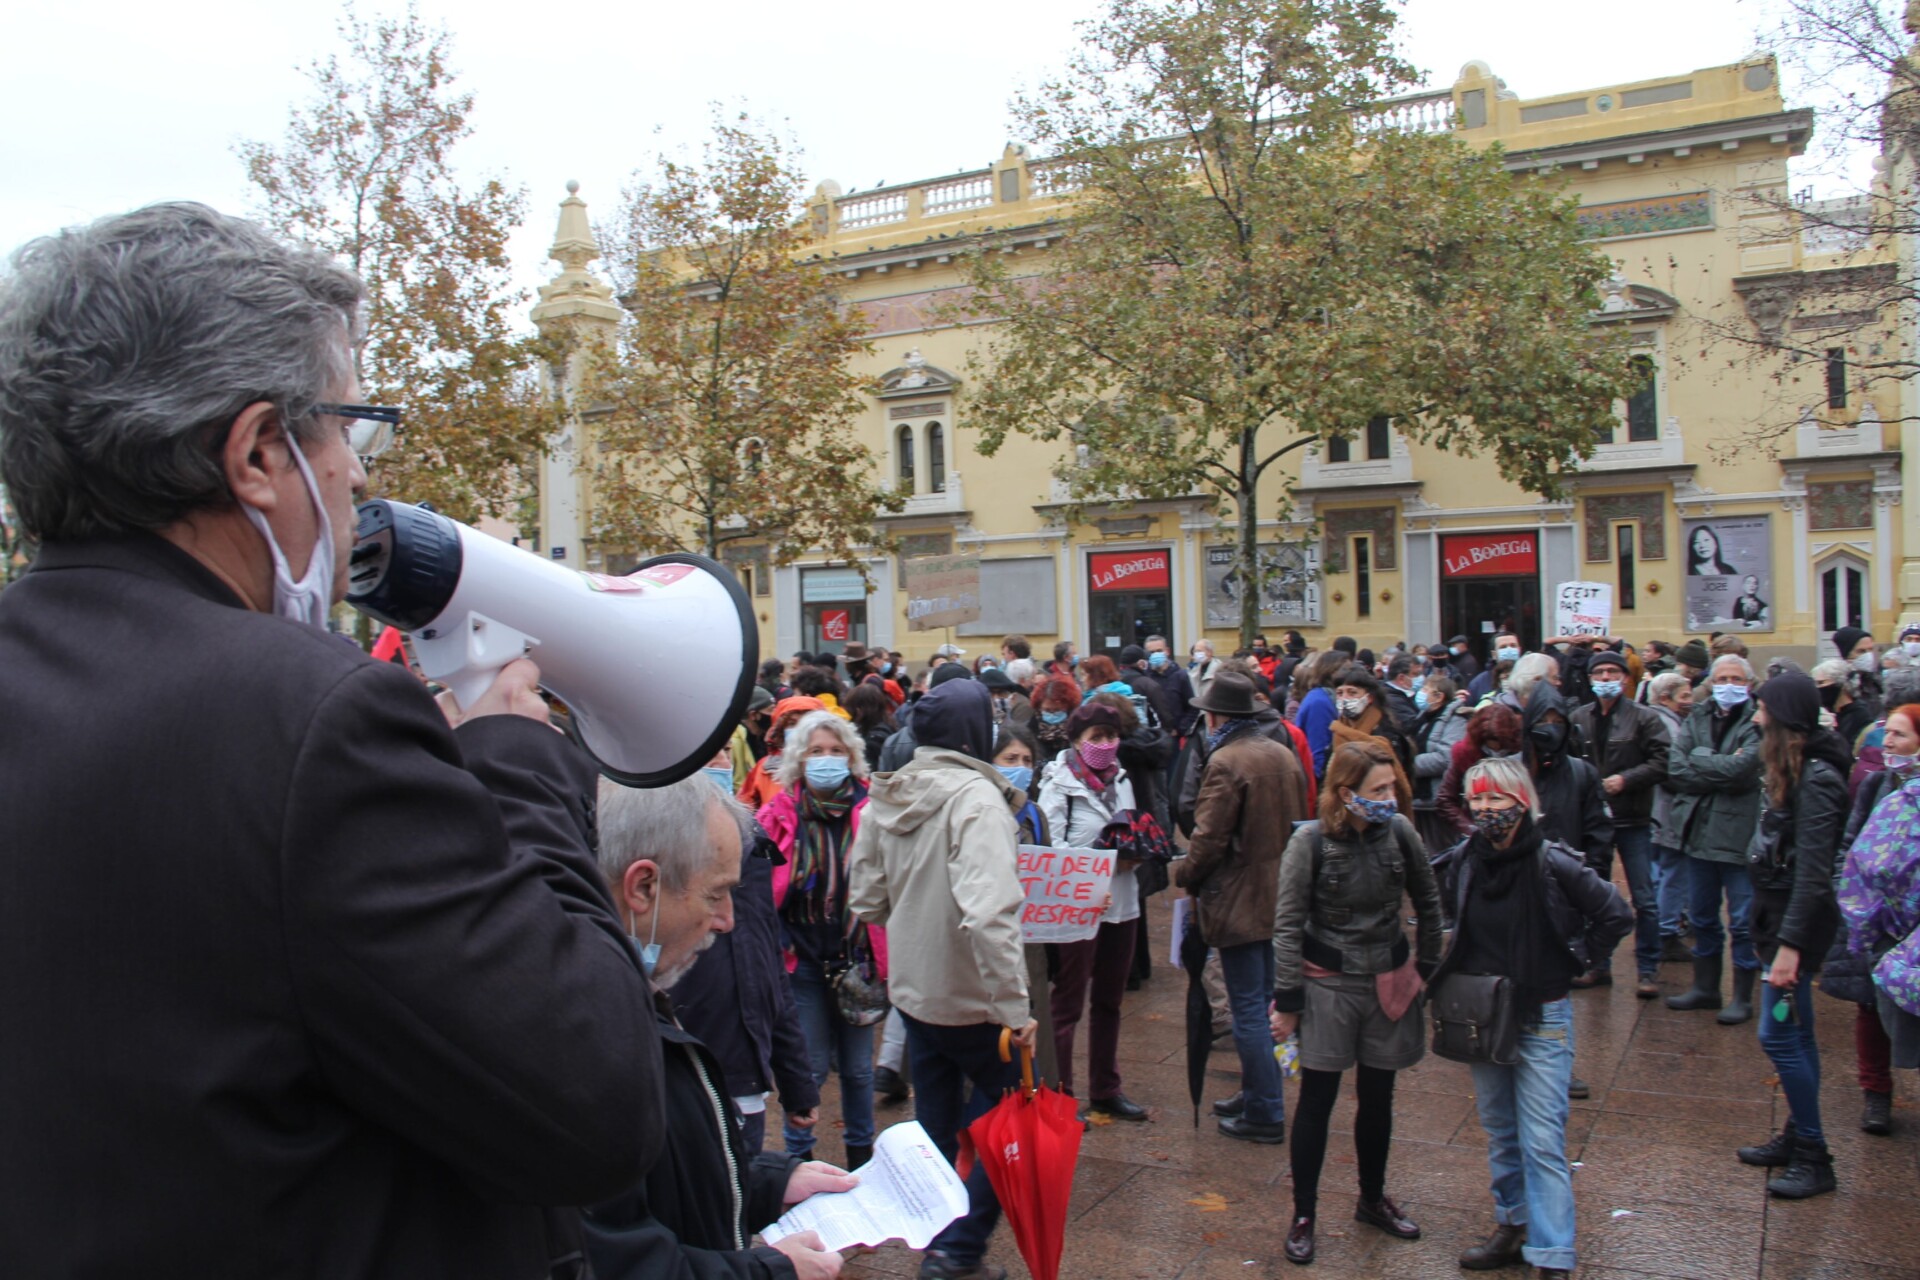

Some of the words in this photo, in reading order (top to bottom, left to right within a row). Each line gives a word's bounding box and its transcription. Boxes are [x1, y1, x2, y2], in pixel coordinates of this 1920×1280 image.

[1444, 555, 1471, 574] LA
[1092, 571, 1115, 588] LA
[1060, 855, 1092, 877] DE
[1091, 856, 1112, 878] LA
[1021, 902, 1104, 928] RESPECT
